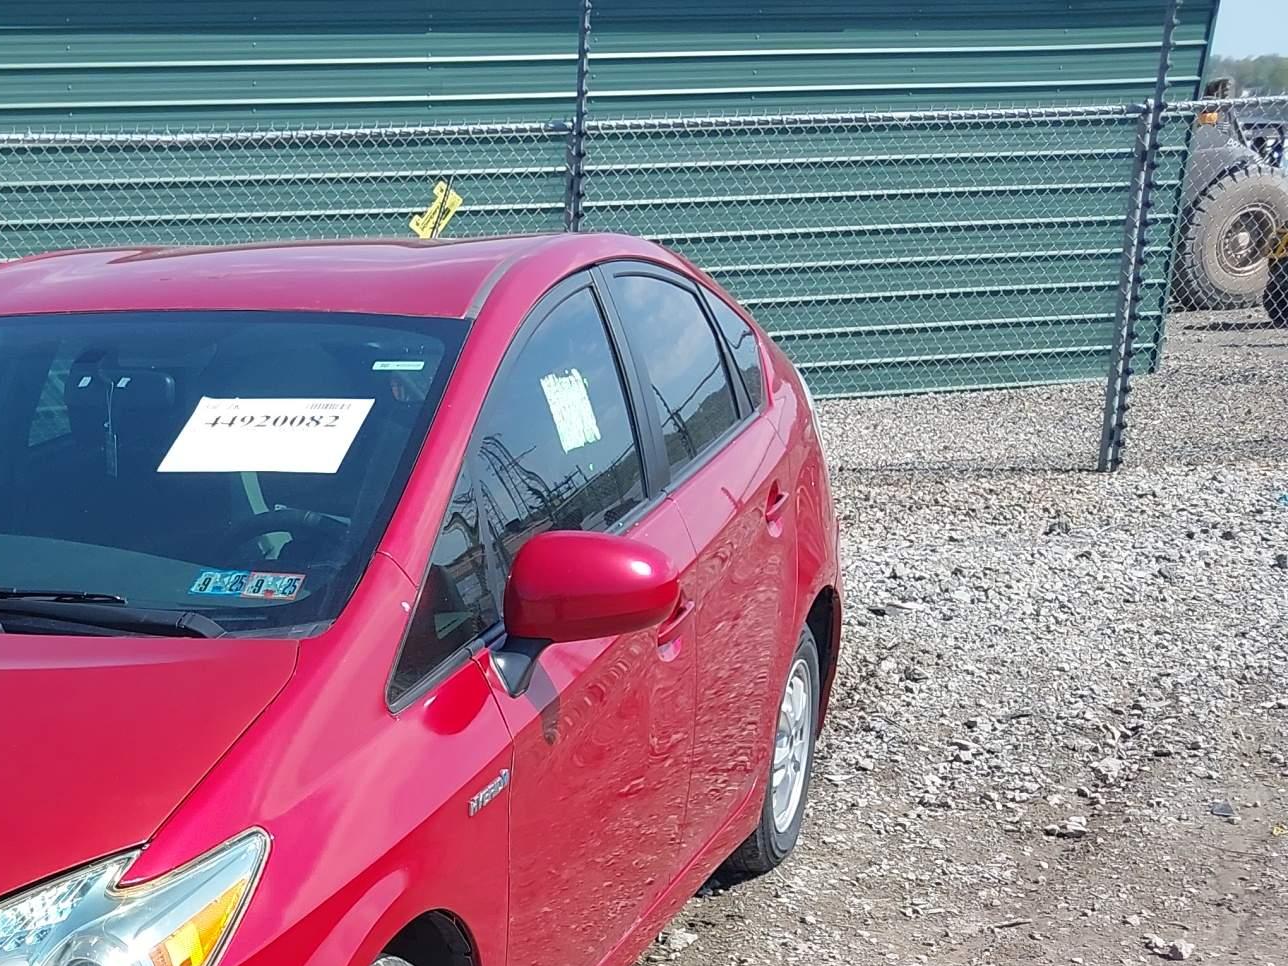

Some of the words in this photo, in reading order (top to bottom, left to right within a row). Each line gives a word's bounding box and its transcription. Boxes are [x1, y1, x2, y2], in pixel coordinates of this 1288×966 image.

[204, 415, 340, 428] 44920082
[199, 578, 211, 592] 9
[231, 575, 247, 592] 25
[253, 579, 265, 594] 9
[282, 578, 301, 596] 25
